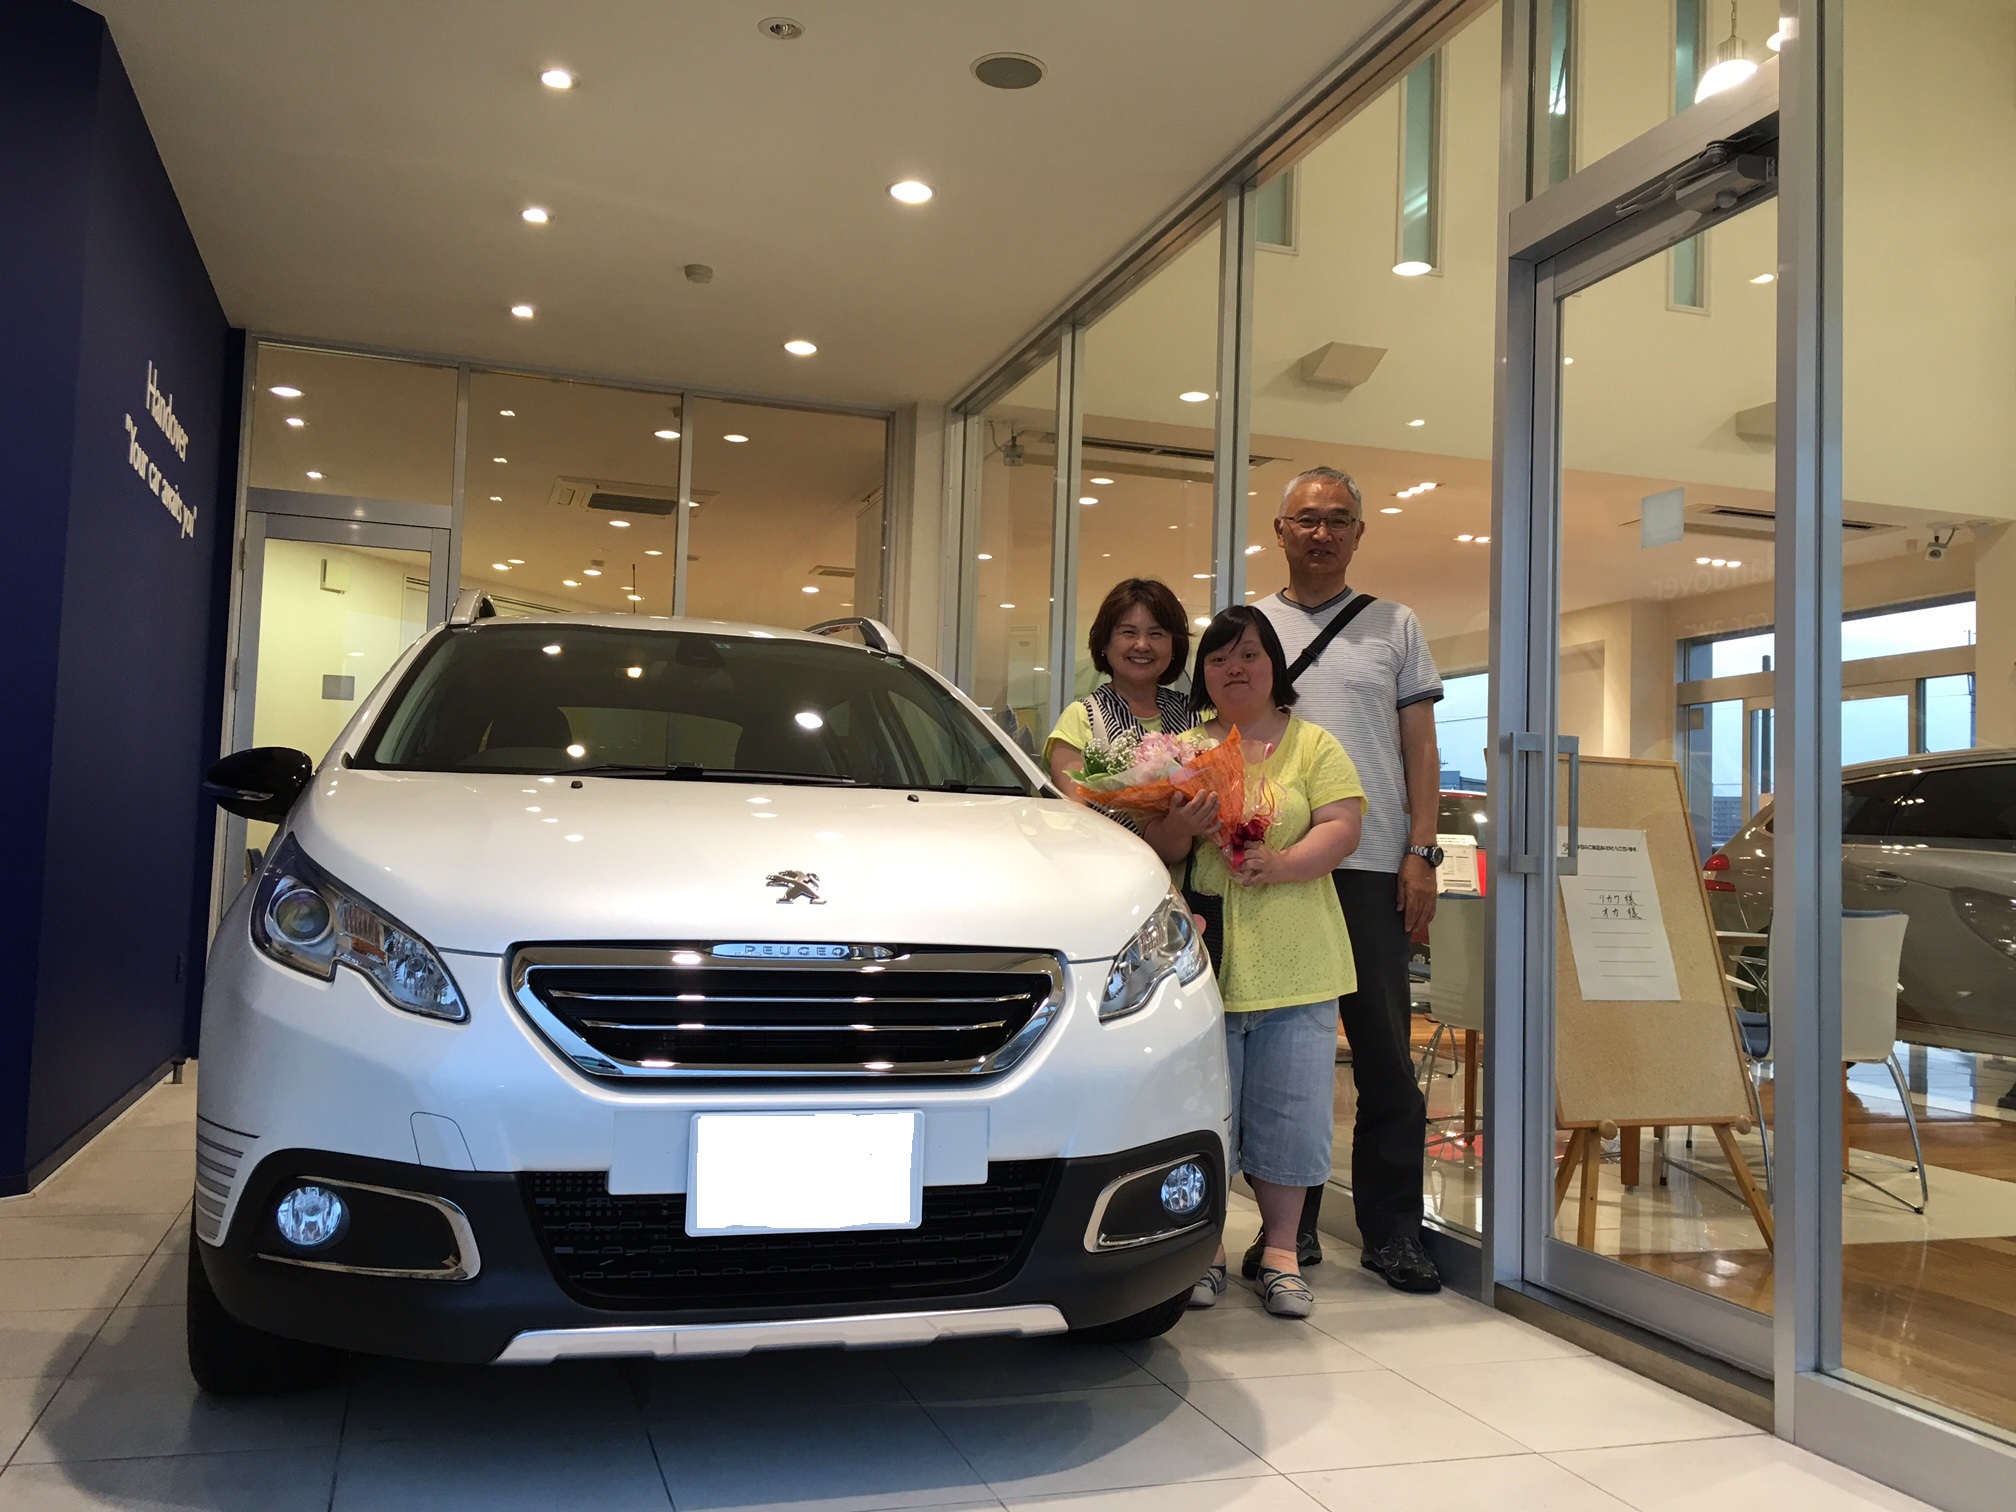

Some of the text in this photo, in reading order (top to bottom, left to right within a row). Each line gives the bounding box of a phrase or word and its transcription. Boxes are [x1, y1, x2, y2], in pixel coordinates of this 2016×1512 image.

[146, 359, 189, 463] Handover
[148, 462, 162, 496] car
[161, 478, 183, 524] awaits
[744, 944, 863, 957] PEUGEOT
